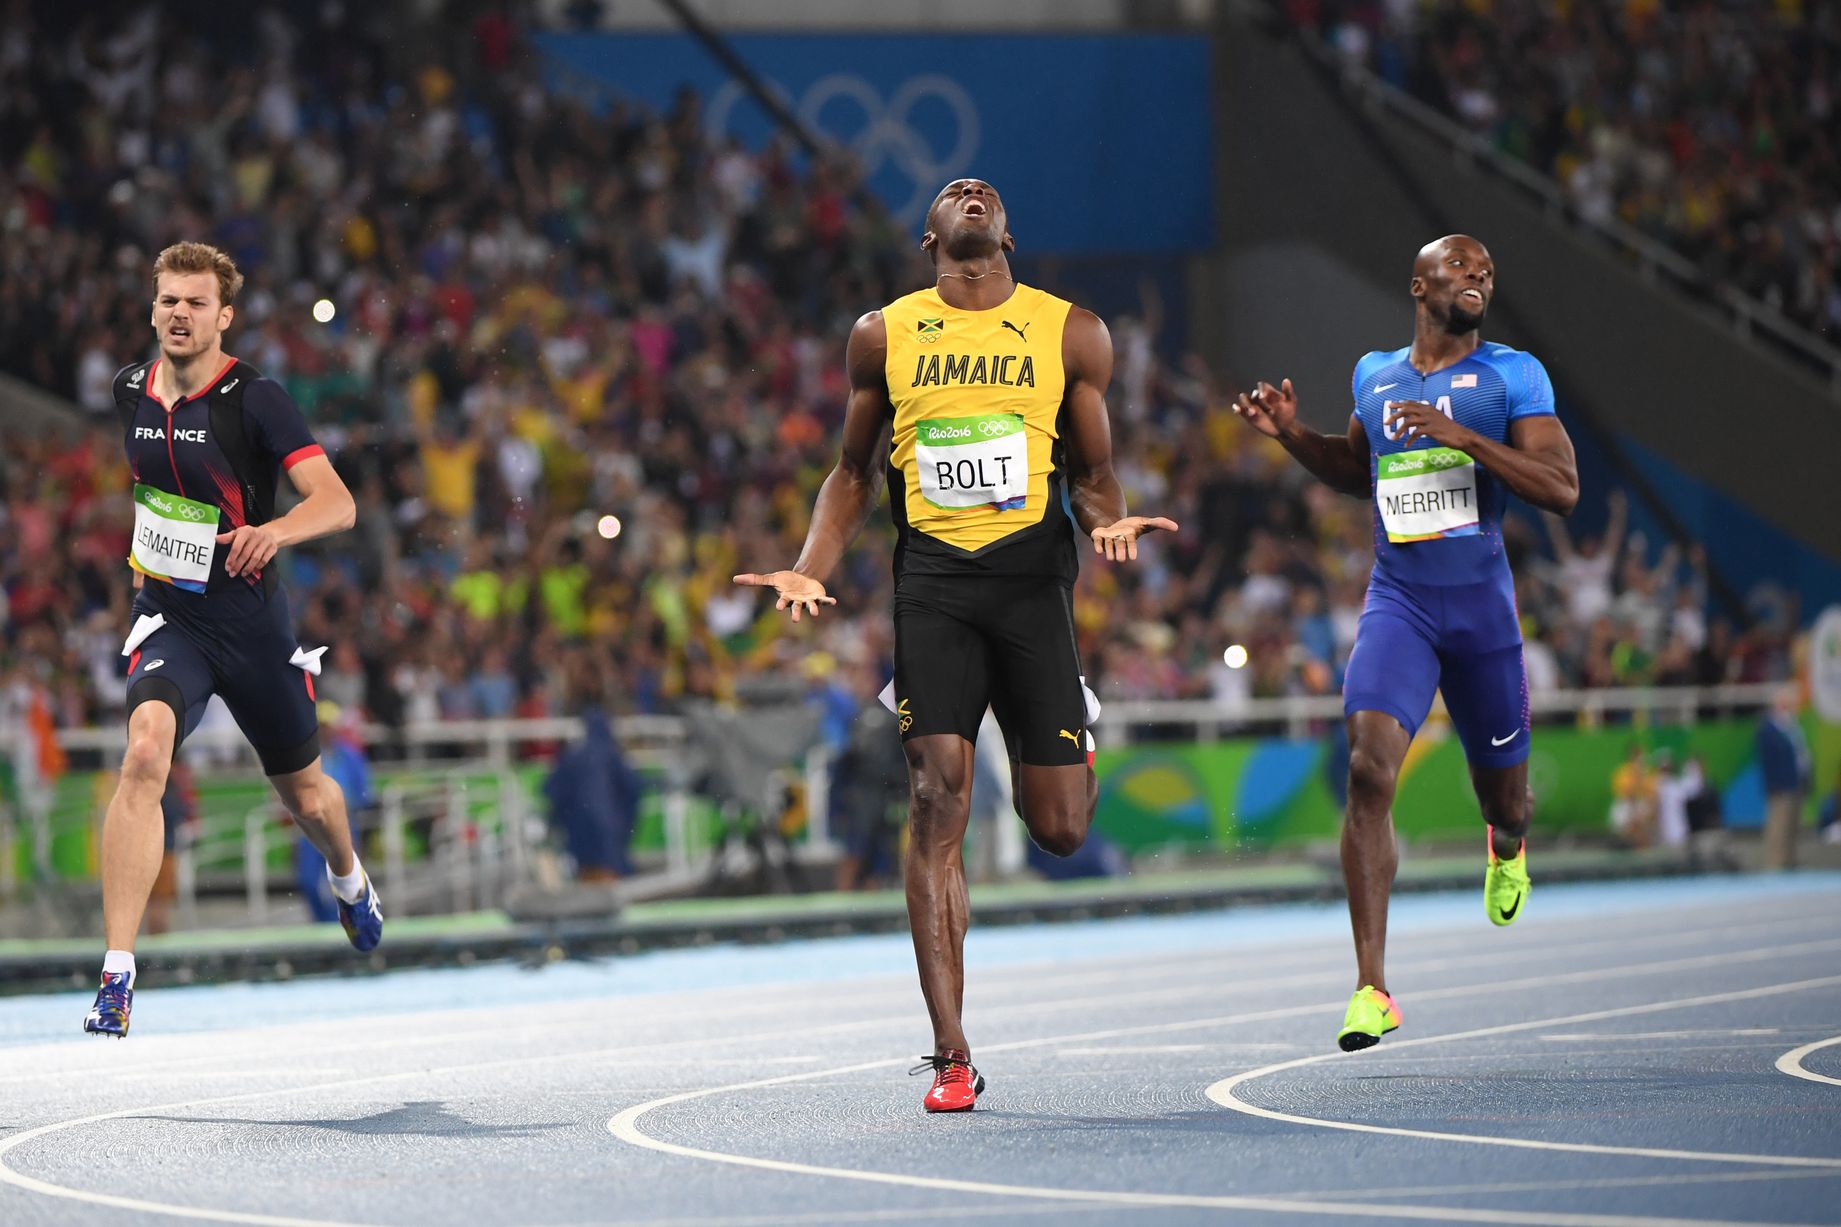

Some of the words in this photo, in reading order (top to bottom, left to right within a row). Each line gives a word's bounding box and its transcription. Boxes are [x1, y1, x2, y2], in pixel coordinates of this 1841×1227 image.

[911, 354, 1035, 388] JAMAICA
[135, 427, 207, 443] FRANCE
[936, 456, 1012, 490] BOLT
[1386, 487, 1471, 516] MERRITT
[138, 522, 209, 566] LEMAITRE
